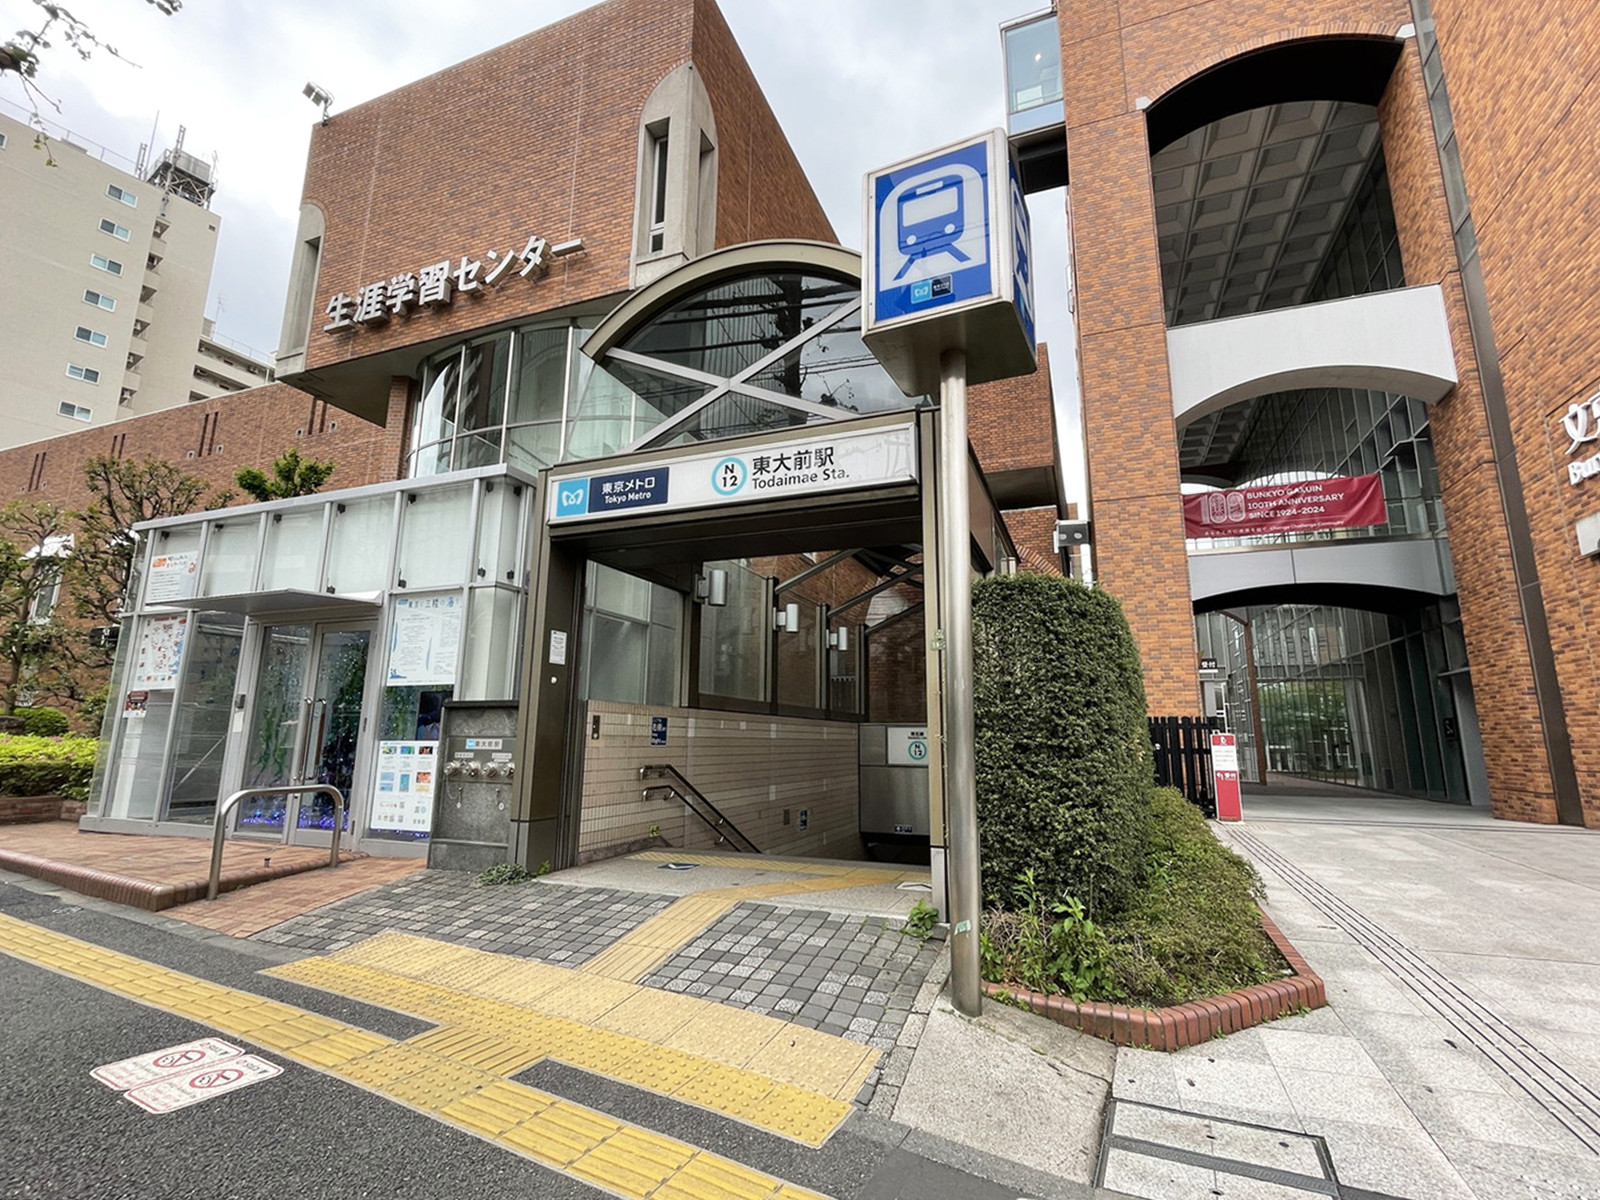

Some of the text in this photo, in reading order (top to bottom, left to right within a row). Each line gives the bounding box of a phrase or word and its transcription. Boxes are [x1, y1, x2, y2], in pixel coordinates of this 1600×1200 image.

[323, 235, 585, 333] 生涯学習センター
[752, 446, 835, 476] 東大前駅
[724, 464, 735, 475] N
[722, 475, 738, 488] 12
[752, 468, 850, 489] Todaimae Sta.
[601, 477, 655, 495] 東京メトロ
[604, 491, 652, 504] Tokyo Metro
[1246, 489, 1285, 500] BUNKYO
[1278, 492, 1345, 506] ANNIVERSARY
